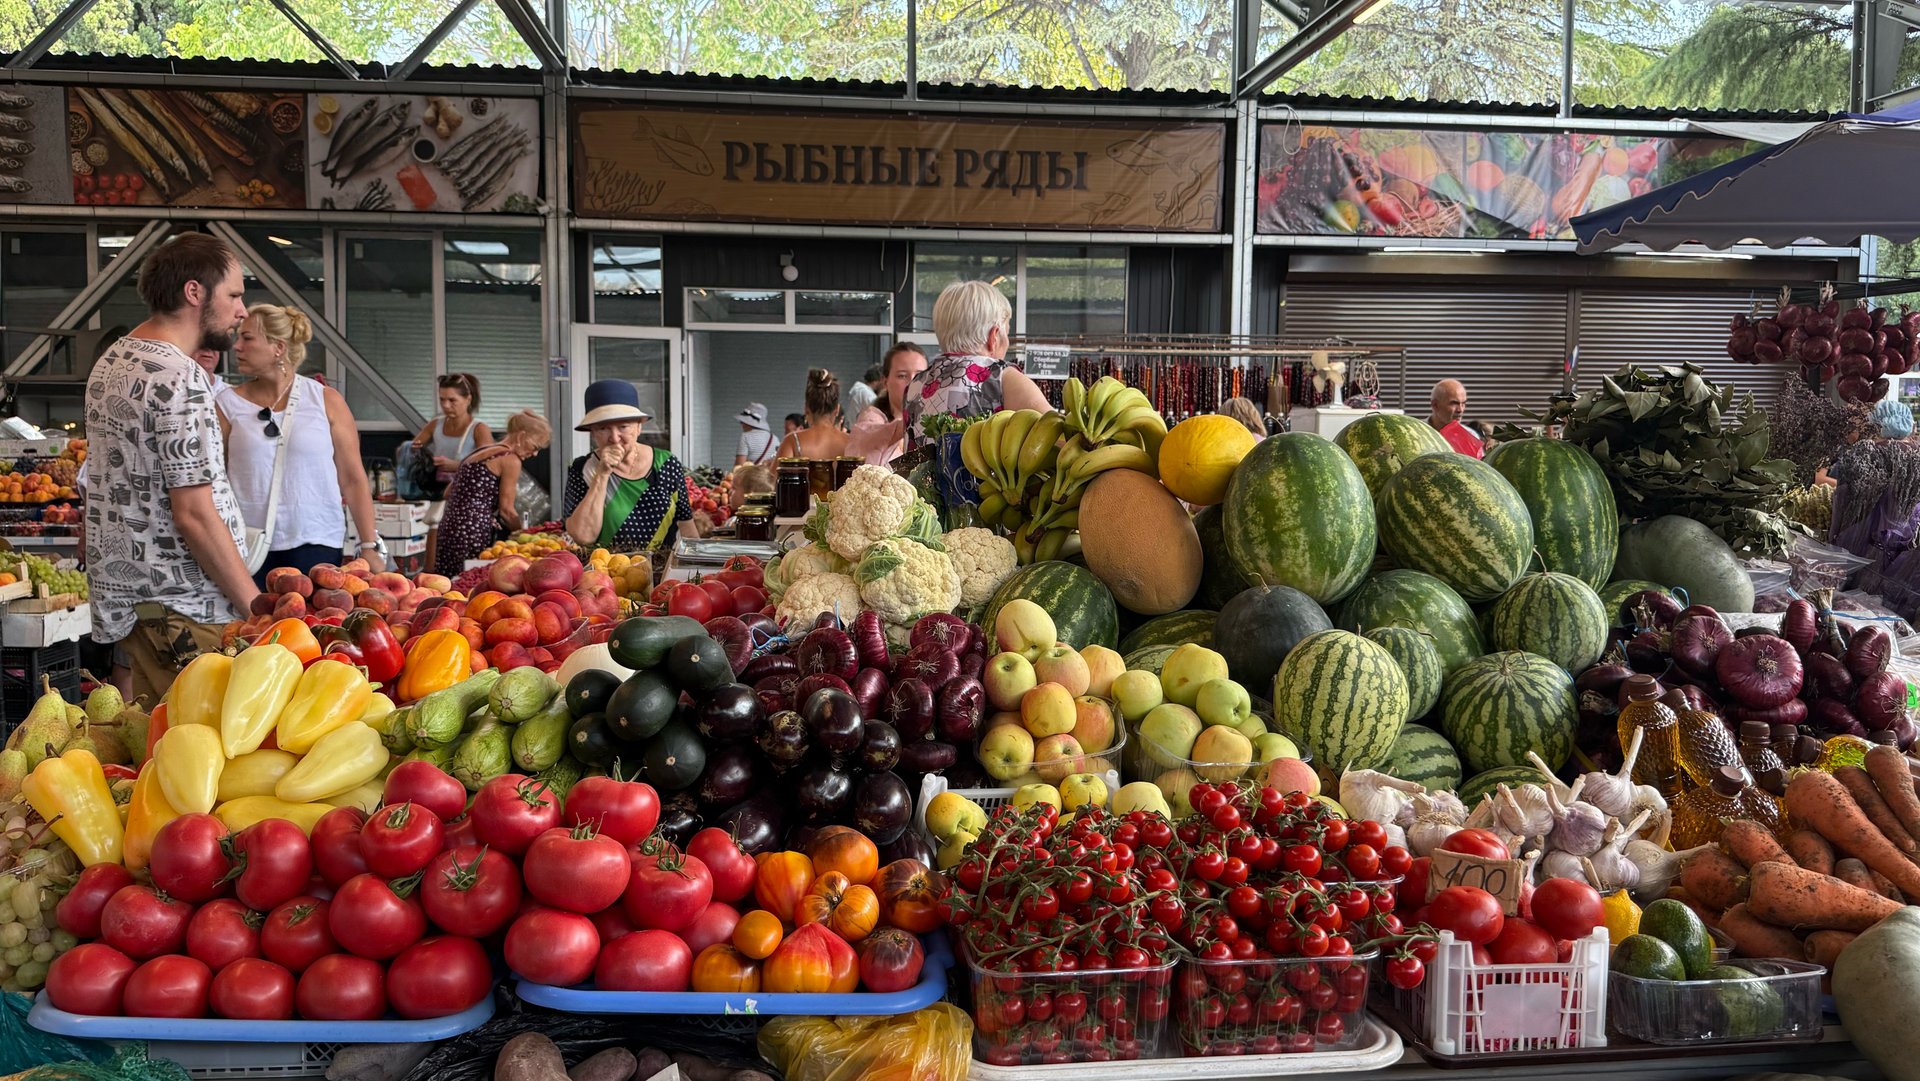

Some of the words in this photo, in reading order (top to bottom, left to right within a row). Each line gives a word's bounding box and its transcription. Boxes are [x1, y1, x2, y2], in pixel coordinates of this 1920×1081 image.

[722, 141, 941, 187] РЫБНЫЕ
[953, 149, 1089, 197] РЯДЫ
[1436, 859, 1507, 896] 100
